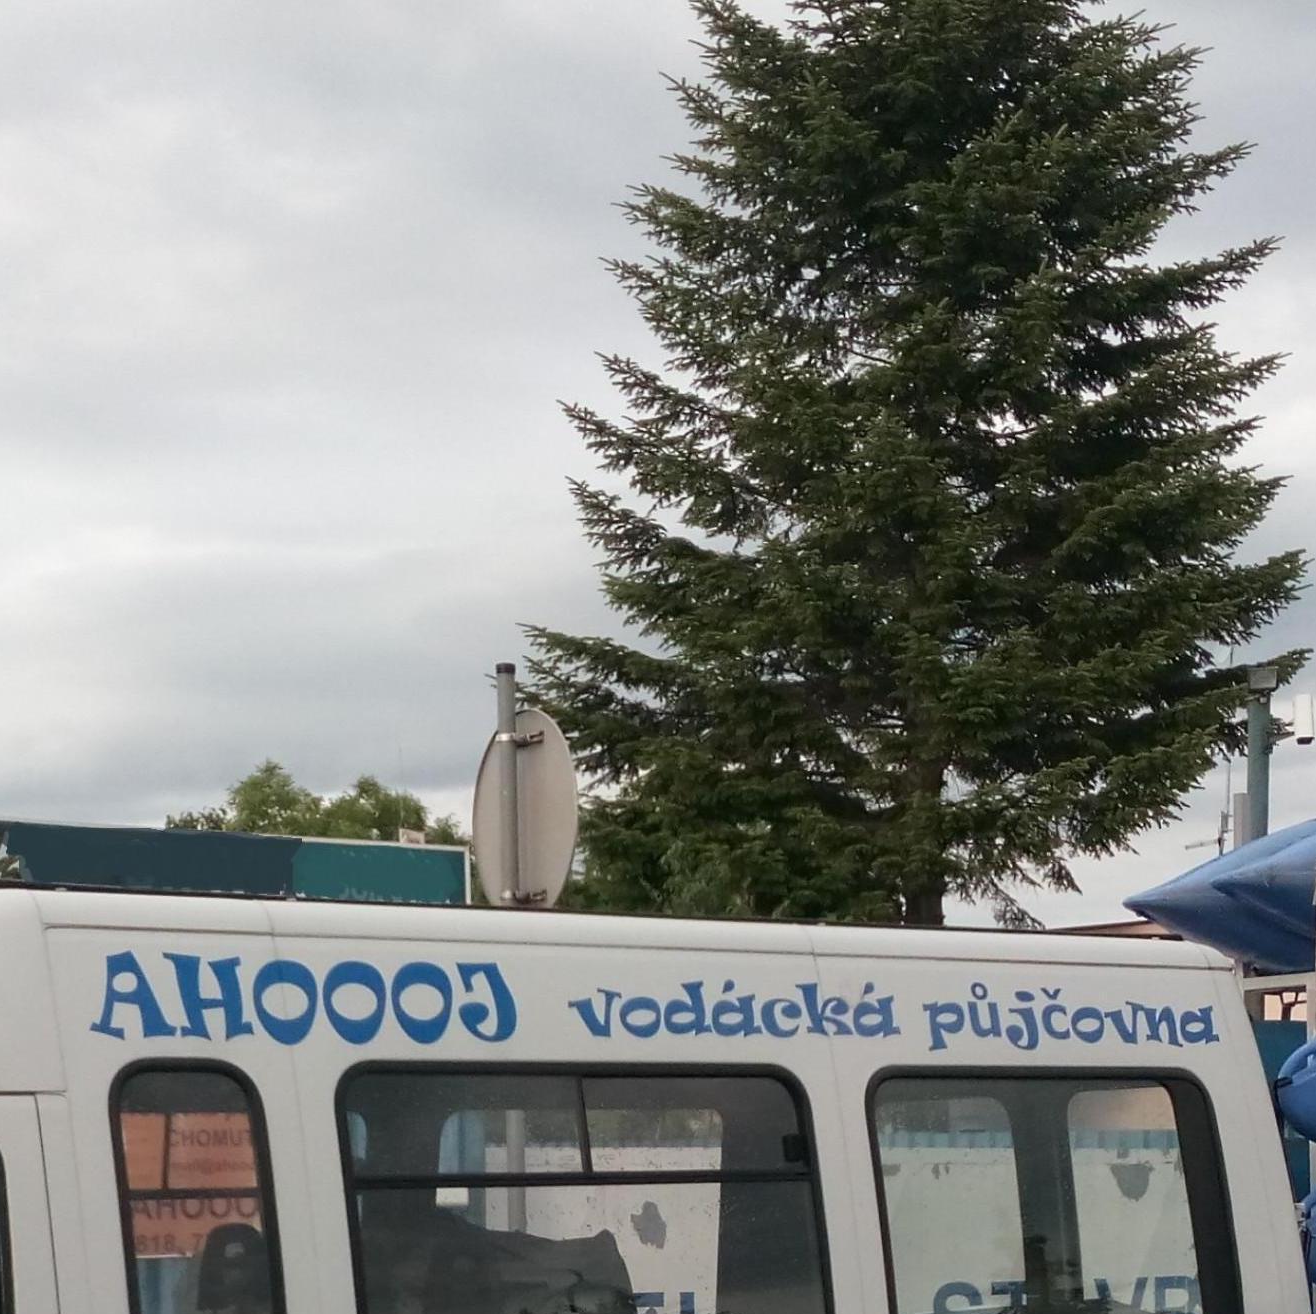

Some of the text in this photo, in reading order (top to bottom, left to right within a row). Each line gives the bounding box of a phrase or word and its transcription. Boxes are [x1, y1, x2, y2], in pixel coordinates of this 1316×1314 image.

[90, 950, 1219, 1050] AHOOOJ vodácká půjčovna
